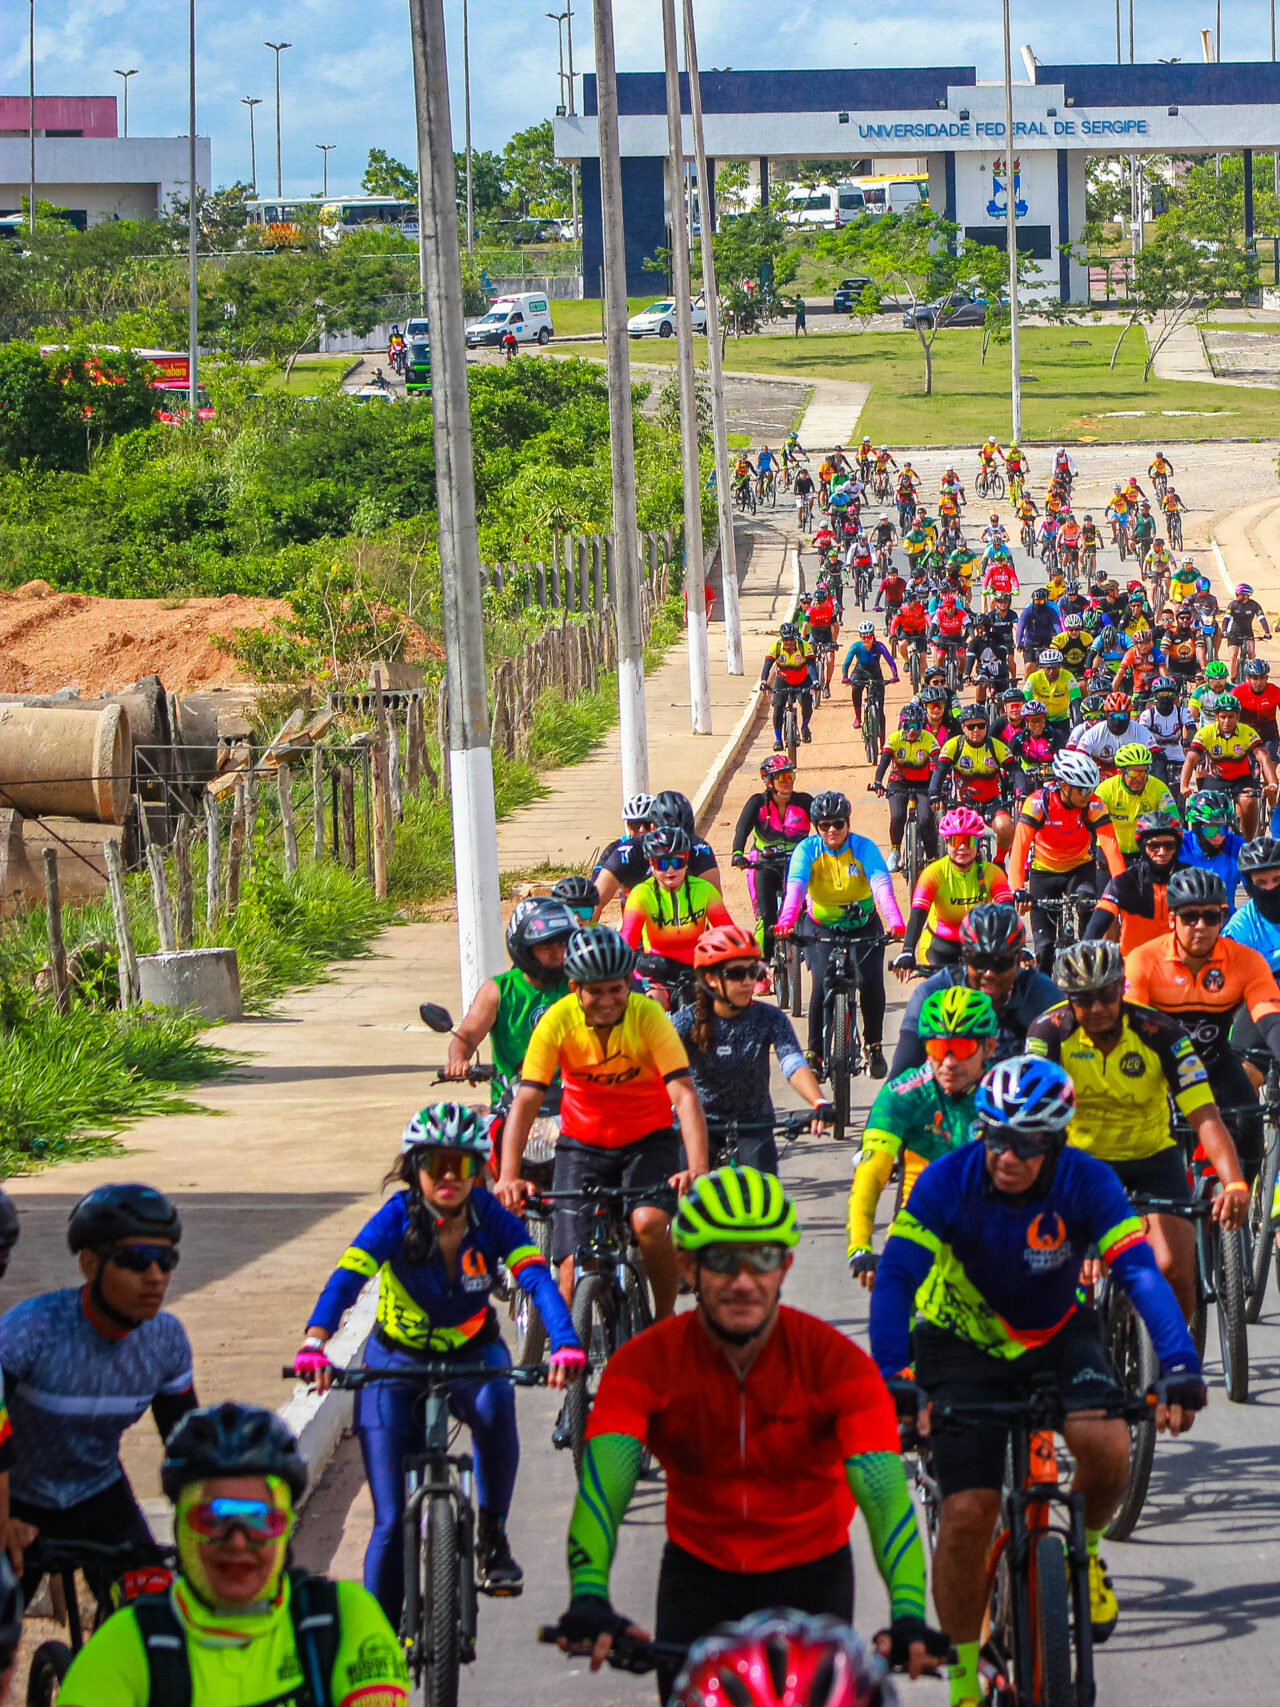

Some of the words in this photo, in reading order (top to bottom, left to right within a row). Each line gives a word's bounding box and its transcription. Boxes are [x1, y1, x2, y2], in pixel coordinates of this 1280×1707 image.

[858, 121, 970, 138] UNIVERSIDADE
[976, 120, 1048, 137] FEDERAL
[1054, 120, 1076, 136] DE
[1081, 119, 1147, 135] SERGIPE
